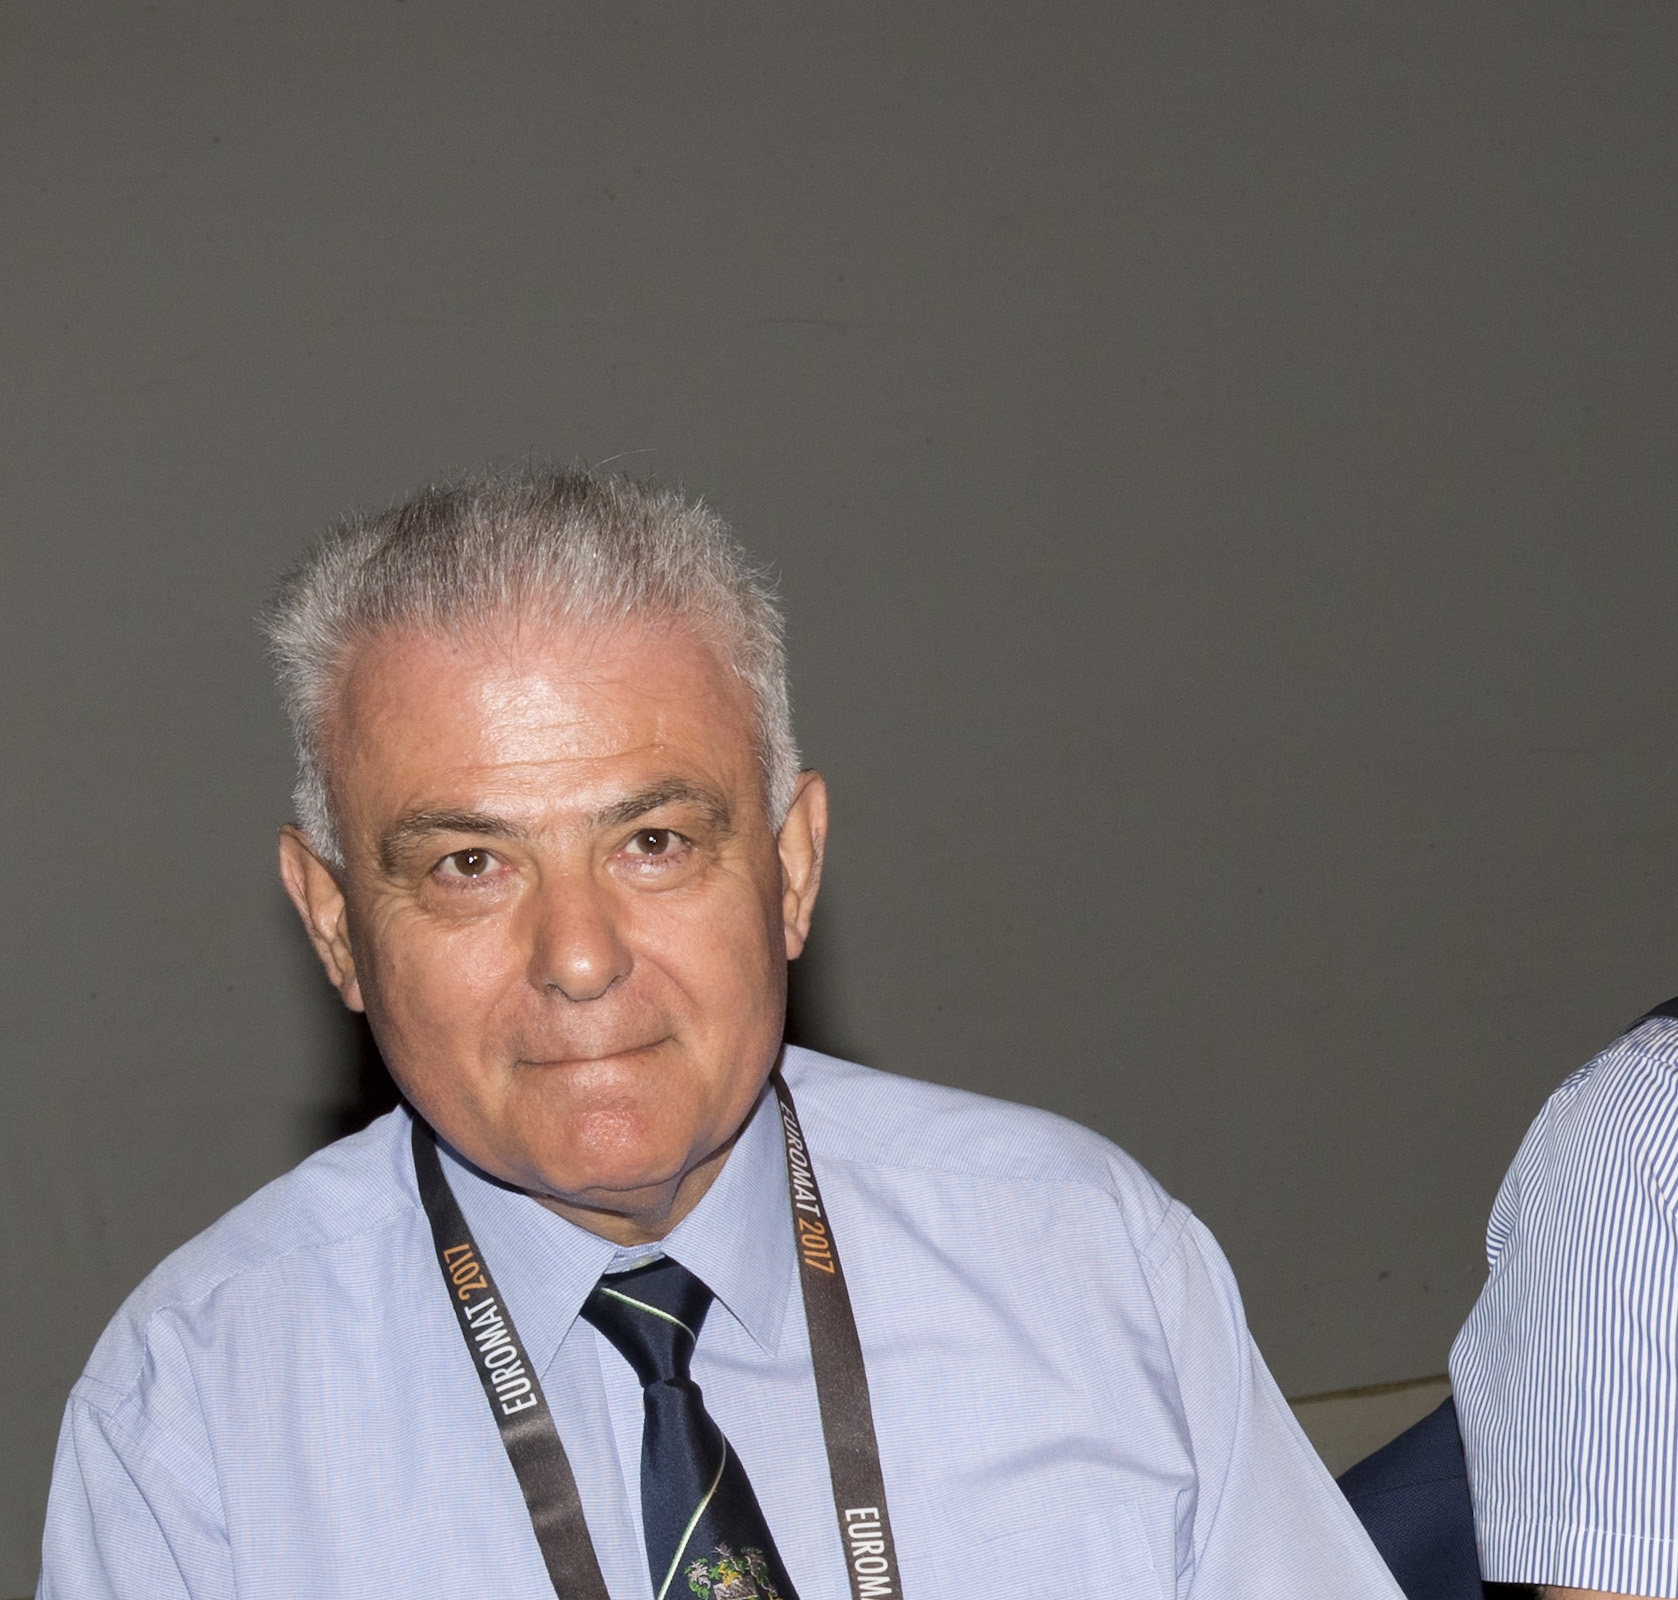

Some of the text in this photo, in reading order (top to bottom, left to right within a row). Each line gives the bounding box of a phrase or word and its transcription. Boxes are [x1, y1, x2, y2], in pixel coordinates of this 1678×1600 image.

[780, 1101, 836, 1274] EUROMAT 2017
[443, 1243, 538, 1416] EUROMAT 2017
